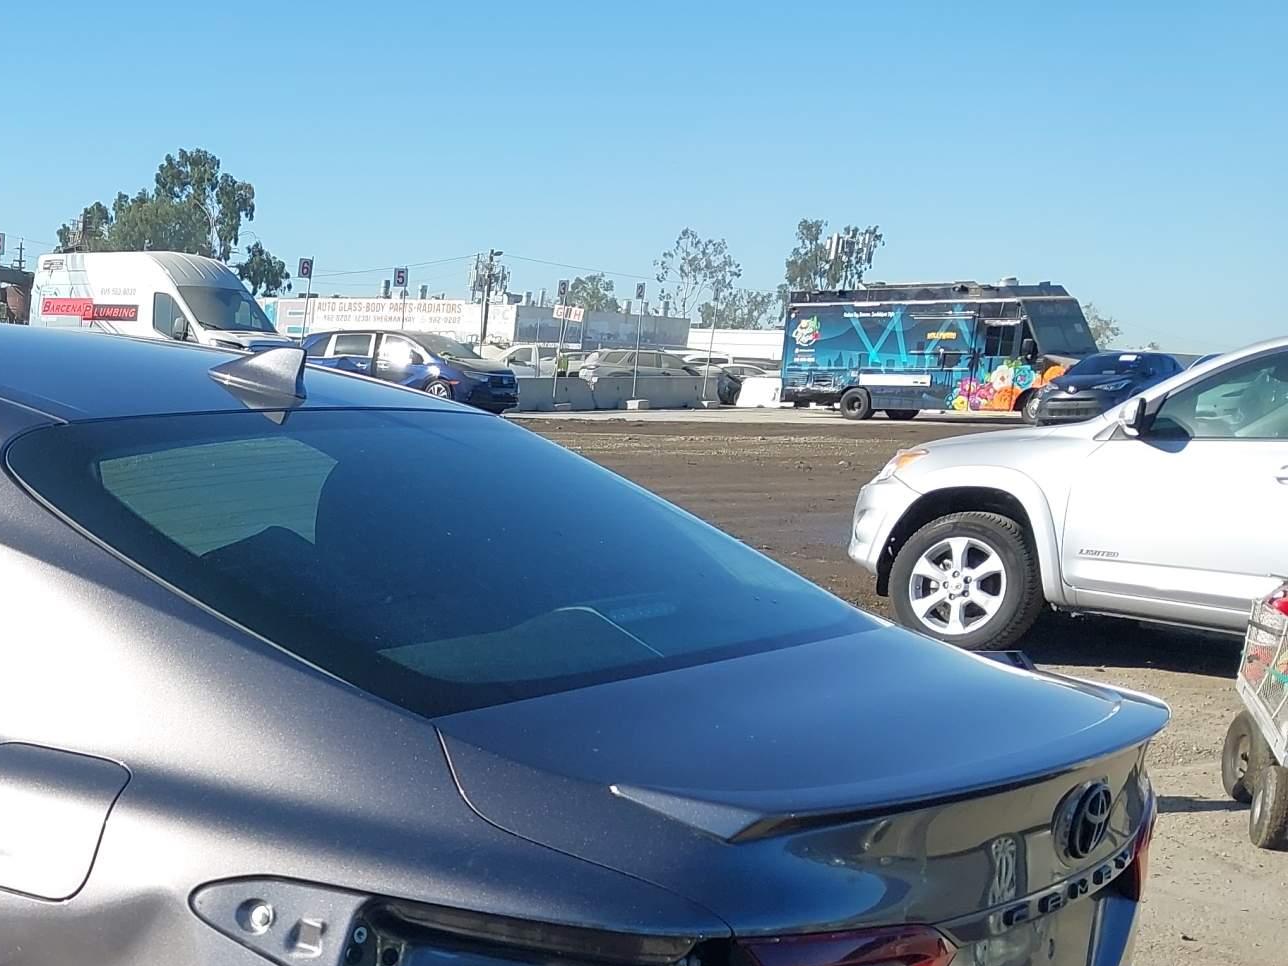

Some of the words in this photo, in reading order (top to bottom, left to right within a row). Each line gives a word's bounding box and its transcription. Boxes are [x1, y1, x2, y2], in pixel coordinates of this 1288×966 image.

[300, 260, 310, 276] 6
[397, 270, 405, 284] 5
[559, 281, 566, 295] 3
[636, 285, 644, 297] 2
[42, 300, 83, 313] BARCENA
[83, 304, 137, 318] PLUMBING
[317, 301, 336, 312] AUTO
[556, 308, 564, 319] G
[574, 310, 582, 321] H
[1078, 548, 1120, 558] LIMITED
